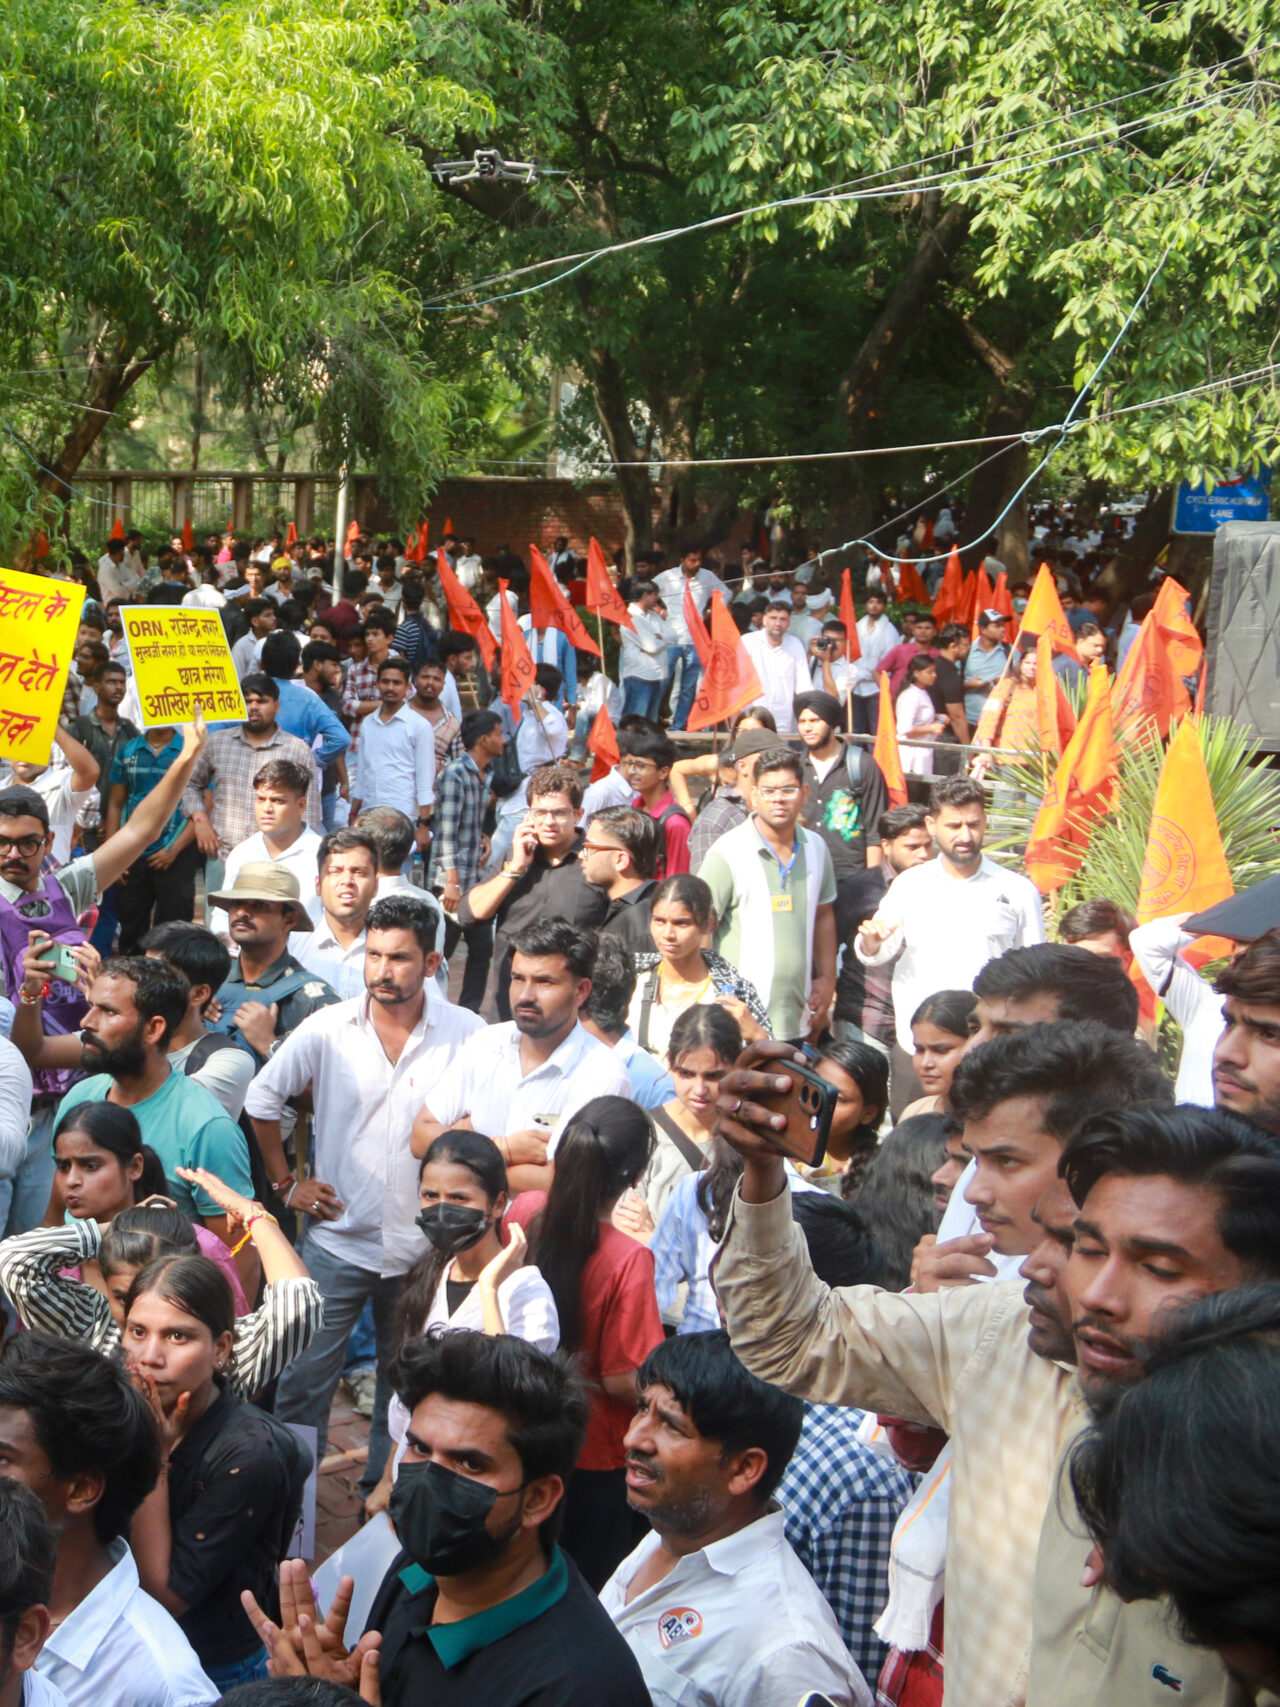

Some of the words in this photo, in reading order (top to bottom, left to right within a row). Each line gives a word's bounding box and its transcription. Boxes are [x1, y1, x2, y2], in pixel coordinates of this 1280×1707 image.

[43, 589, 71, 623] के
[129, 620, 169, 640] ORN,
[161, 644, 178, 658] नगर
[177, 640, 187, 660] हो
[18, 647, 60, 692] देते
[177, 665, 202, 686] छात्र
[201, 660, 228, 685] मरेगा
[144, 685, 190, 718] आखिर
[191, 689, 217, 713] कब
